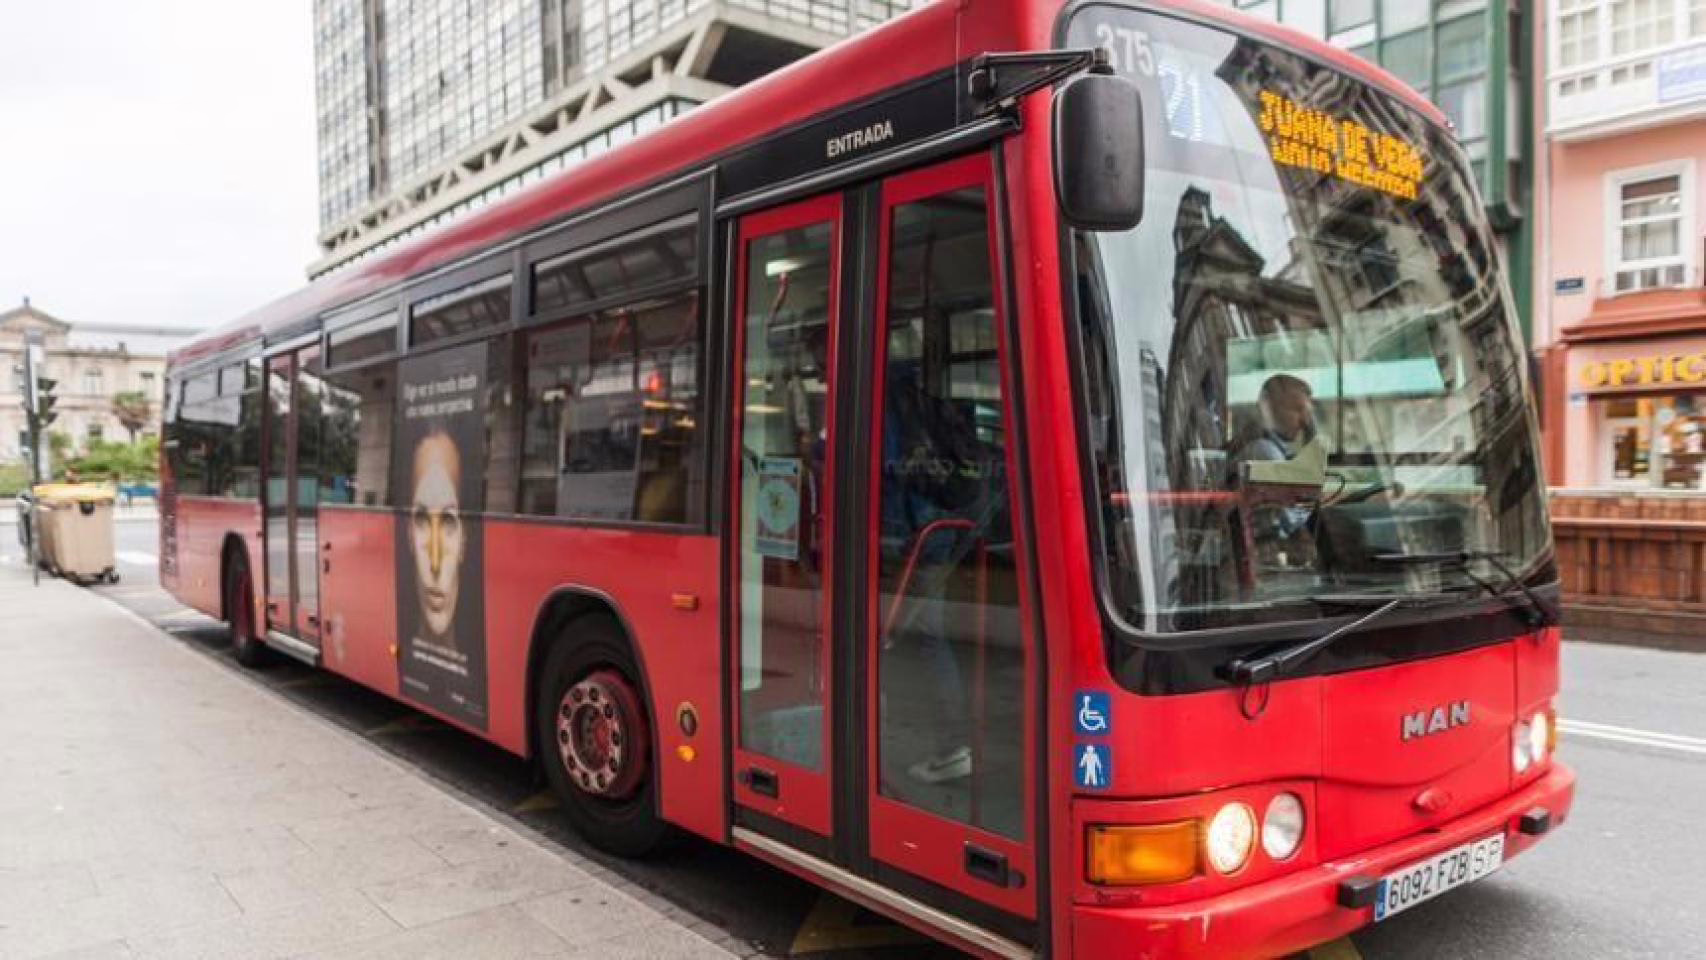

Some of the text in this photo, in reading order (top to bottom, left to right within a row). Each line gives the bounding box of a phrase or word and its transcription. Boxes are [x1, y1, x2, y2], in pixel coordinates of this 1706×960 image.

[1097, 23, 1153, 76] 375
[1158, 65, 1203, 141] 21
[1260, 90, 1338, 153] JUANA
[1344, 121, 1370, 163] DE
[826, 119, 894, 157] ENTRADA
[1402, 701, 1470, 740] MAN
[1389, 865, 1432, 909] 6092
[1438, 850, 1468, 890] FZB
